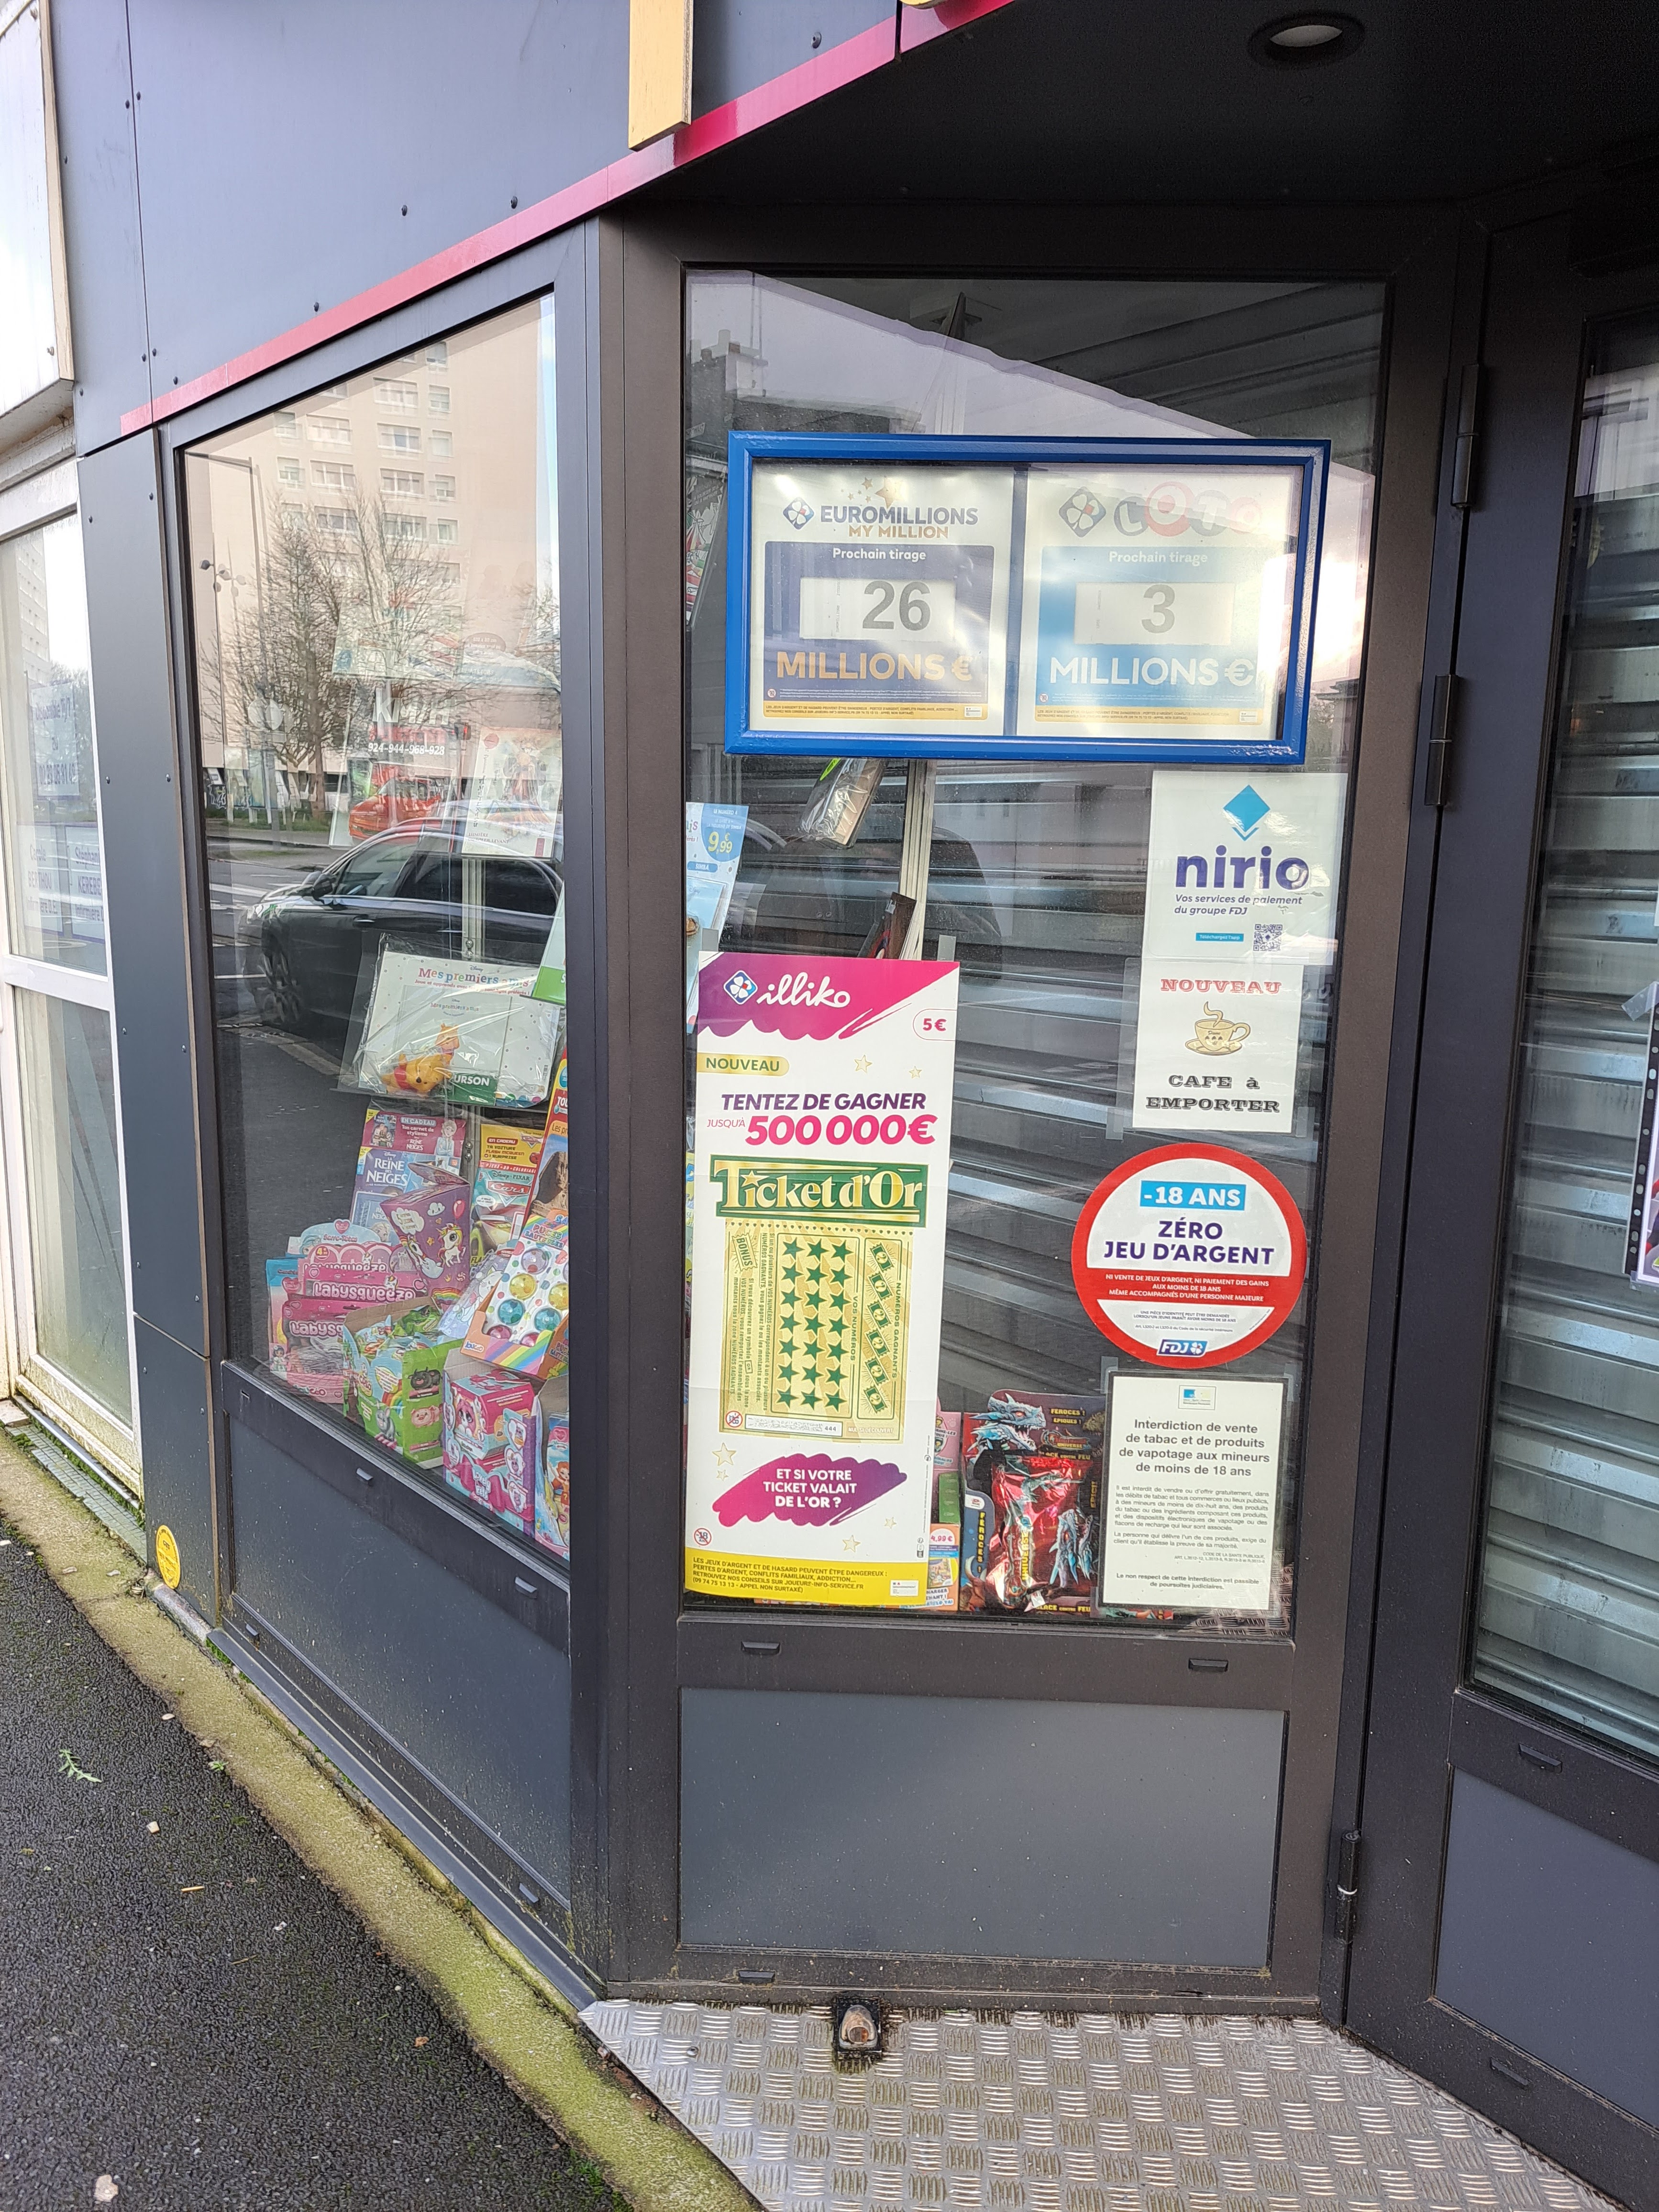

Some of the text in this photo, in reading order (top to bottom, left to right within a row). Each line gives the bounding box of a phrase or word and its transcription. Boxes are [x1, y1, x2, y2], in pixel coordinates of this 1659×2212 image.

[821, 505, 978, 525] EUROMILLIONS
[1114, 481, 1262, 537] LOTO
[849, 525, 948, 538] MY MILLION
[833, 548, 926, 562] Prochain tirage
[1109, 551, 1207, 566] Prochain tirage
[862, 580, 930, 630] 26
[1141, 584, 1175, 633] 3
[776, 651, 973, 681] MILLIONS €
[1050, 657, 1253, 686] MILLIONS €
[1176, 845, 1309, 890] nirio
[1176, 895, 1193, 903] Vos
[1195, 895, 1236, 903] services
[1253, 896, 1303, 905] paiement
[1174, 906, 1248, 916] du groupe FDJ
[419, 968, 498, 984] Mes premiers
[756, 972, 851, 1007] illiko
[1161, 978, 1282, 995] NOUVEAU
[922, 1018, 947, 1031] 5€
[706, 1057, 780, 1072] NOUVEAU
[1168, 1074, 1260, 1089] CAFE à
[721, 1093, 927, 1110] TENTEZ DE GAGNER
[1146, 1096, 1280, 1113] EMPORTER
[552, 1124, 560, 1132] Les
[707, 1117, 746, 1128] JUSQU'À
[374, 1158, 405, 1171] REINE
[366, 1170, 408, 1186] NEIGES
[714, 1161, 922, 1210] Ticket d'Or
[490, 1183, 525, 1194] Cars
[1189, 1188, 1240, 1206] ANS
[533, 1224, 563, 1239] PUCES
[1158, 1217, 1222, 1239] ZÉRO
[736, 1238, 753, 1267] BONUS
[1104, 1241, 1274, 1265] JEU D'ARGENT
[892, 1330, 900, 1379] GAGNANTS
[1161, 1341, 1189, 1353] FDJ
[1135, 1419, 1258, 1433] Interdiction de vente
[1126, 1434, 1265, 1448] de tabac et de produits
[1119, 1448, 1133, 1457] de
[1138, 1449, 1193, 1461] vapotage
[1221, 1452, 1270, 1463] mineurs
[776, 1469, 852, 1481] ET SI VOTRE
[1136, 1462, 1251, 1476] de moins de 18 ans
[763, 1482, 857, 1494] TICKET VALAIT
[775, 1496, 841, 1508] DE L'OR ?
[722, 1561, 752, 1569] D'ARGENT
[717, 1567, 748, 1576] D'ARGENT,
[781, 1572, 815, 1581] FAMILIAUX,
